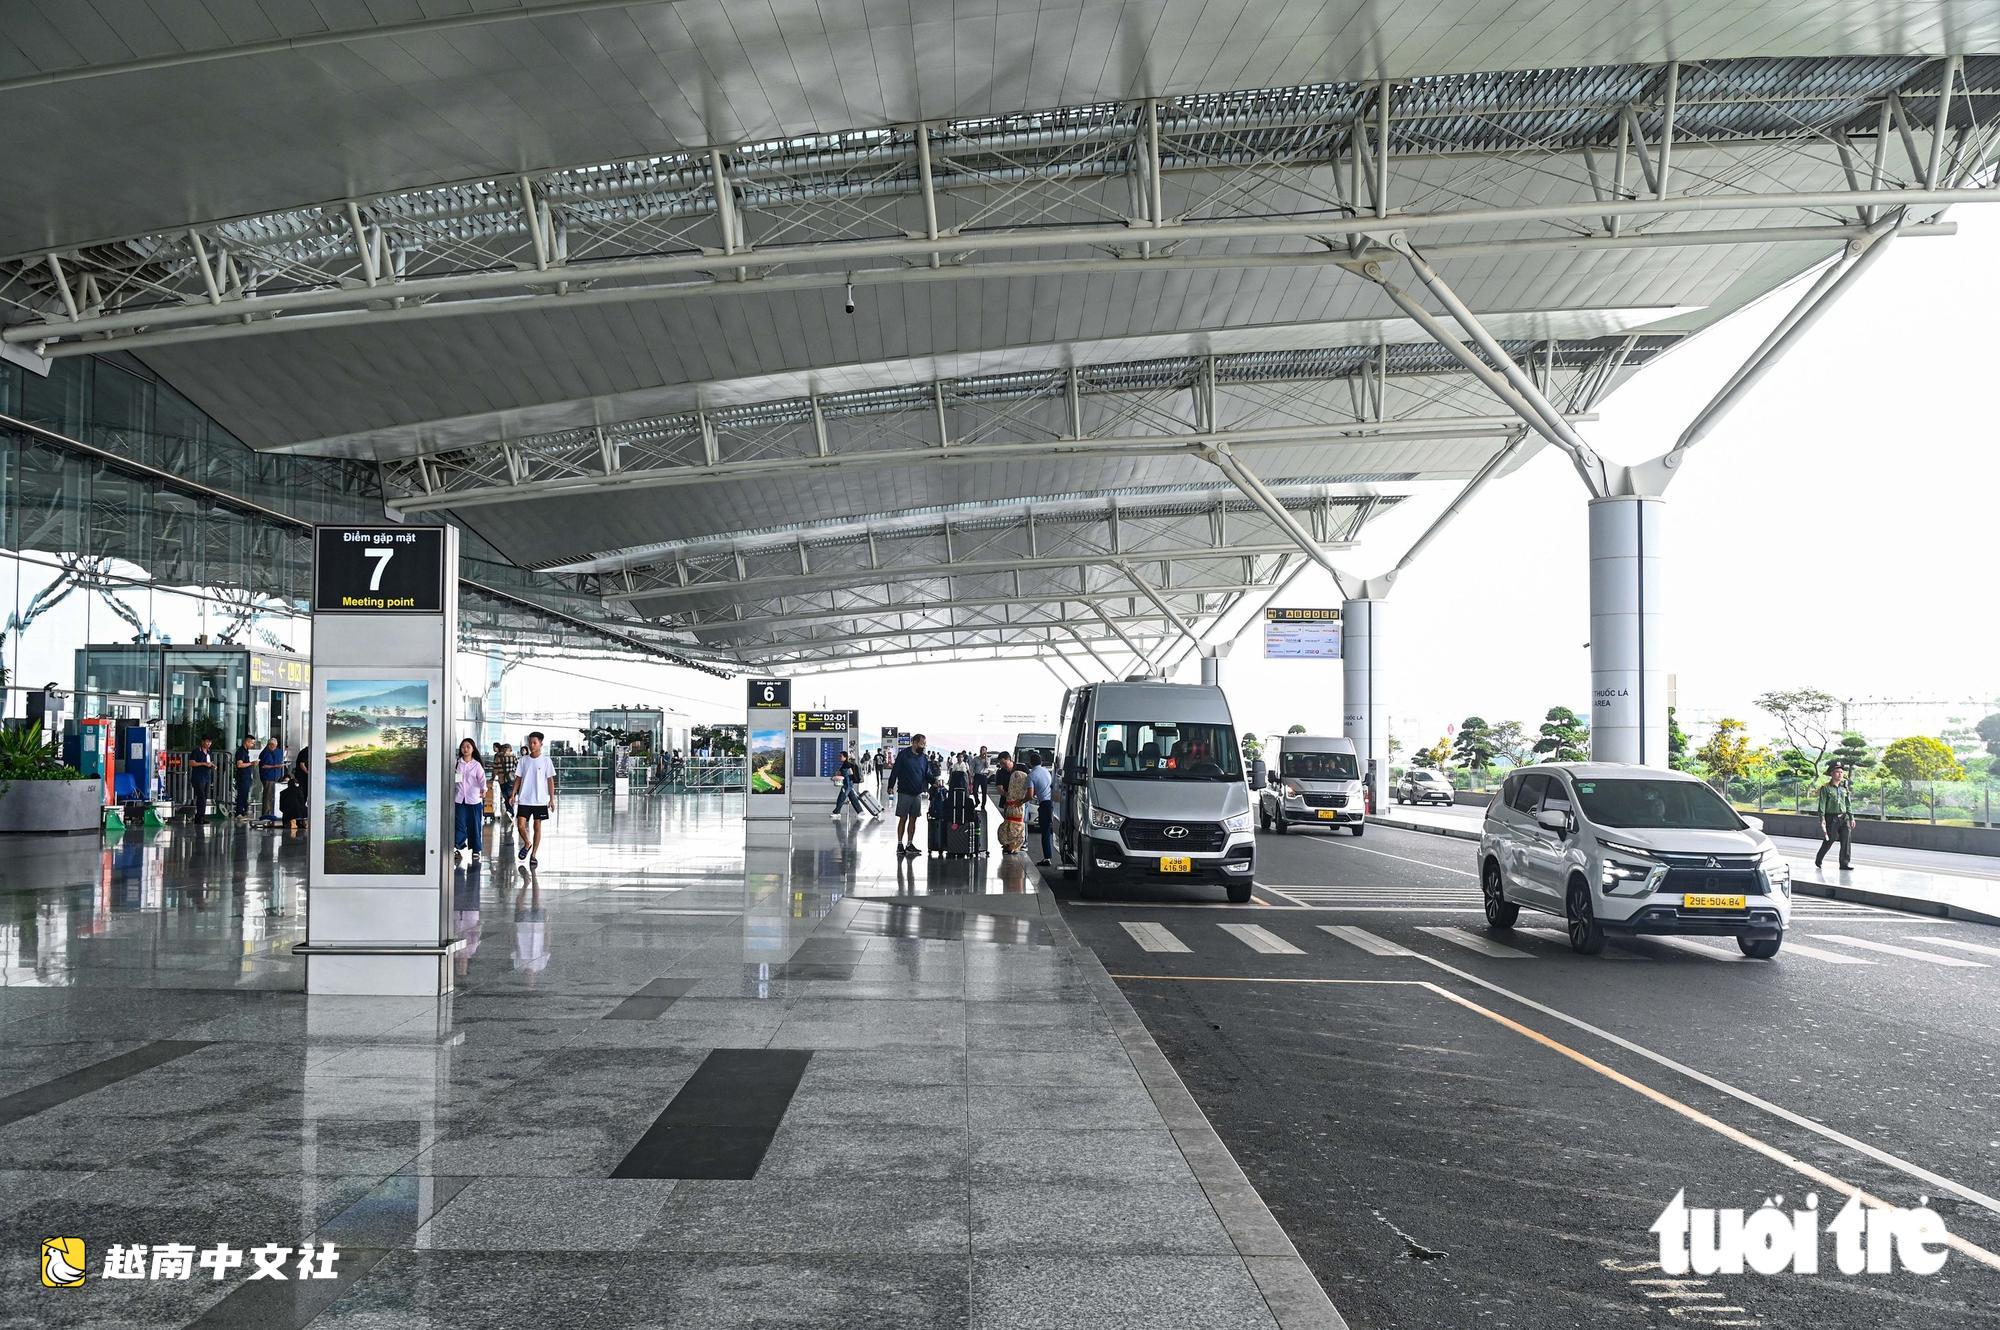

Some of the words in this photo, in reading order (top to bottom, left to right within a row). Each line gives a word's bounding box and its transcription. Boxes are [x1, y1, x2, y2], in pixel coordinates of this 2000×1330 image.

[343, 531, 371, 542] Điểm
[373, 533, 393, 544] gặp
[396, 533, 416, 544] mặt
[364, 548, 394, 591] 7
[342, 597, 384, 608] Meeting
[387, 597, 414, 608] point
[764, 686, 774, 702] 6
[1618, 688, 1629, 696] LÁ
